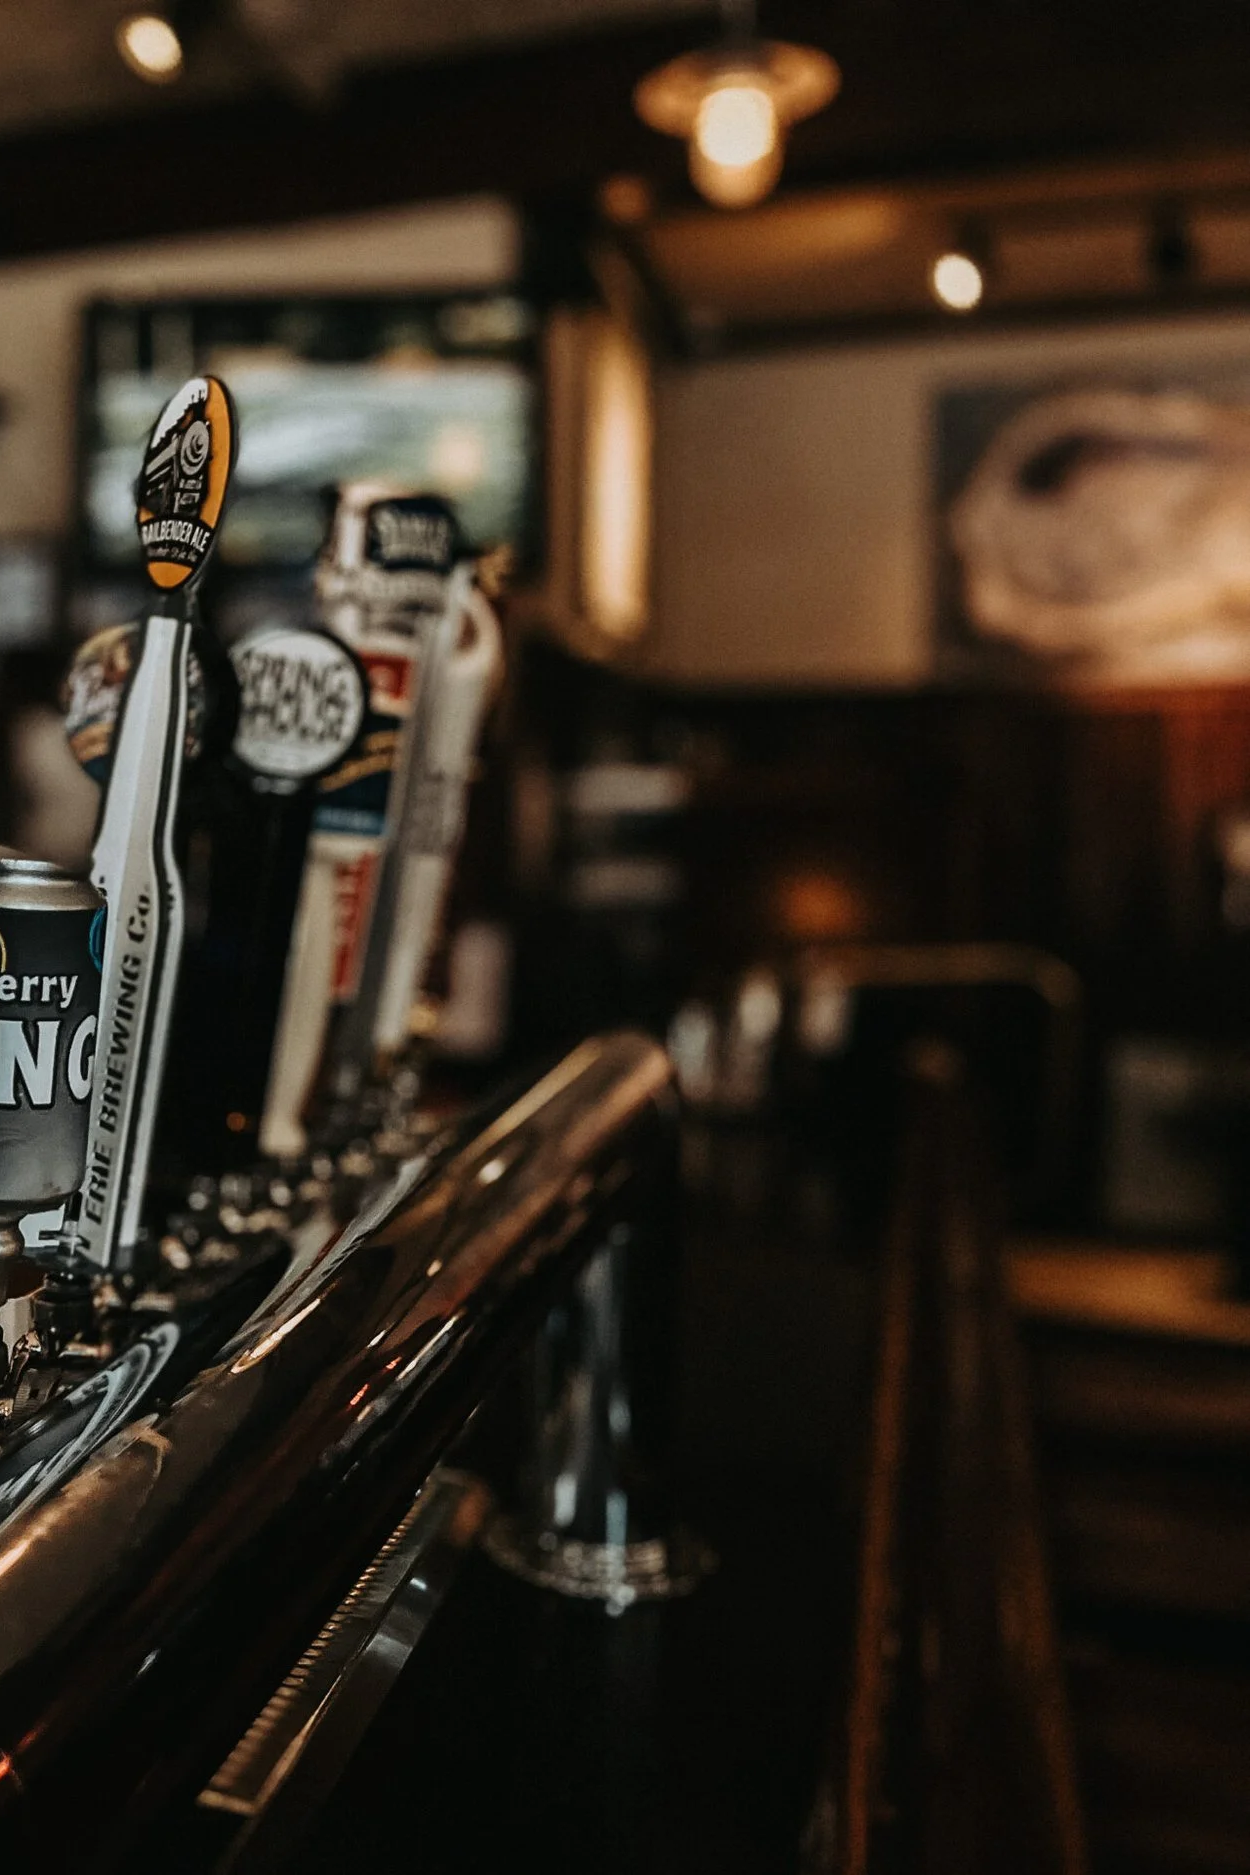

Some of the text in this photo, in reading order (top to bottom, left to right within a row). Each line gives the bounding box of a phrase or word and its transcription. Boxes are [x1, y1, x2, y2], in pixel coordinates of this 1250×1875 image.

[190, 526, 211, 554] ALE
[99, 954, 142, 1133] BREWING
[85, 1140, 114, 1225] ERIE
